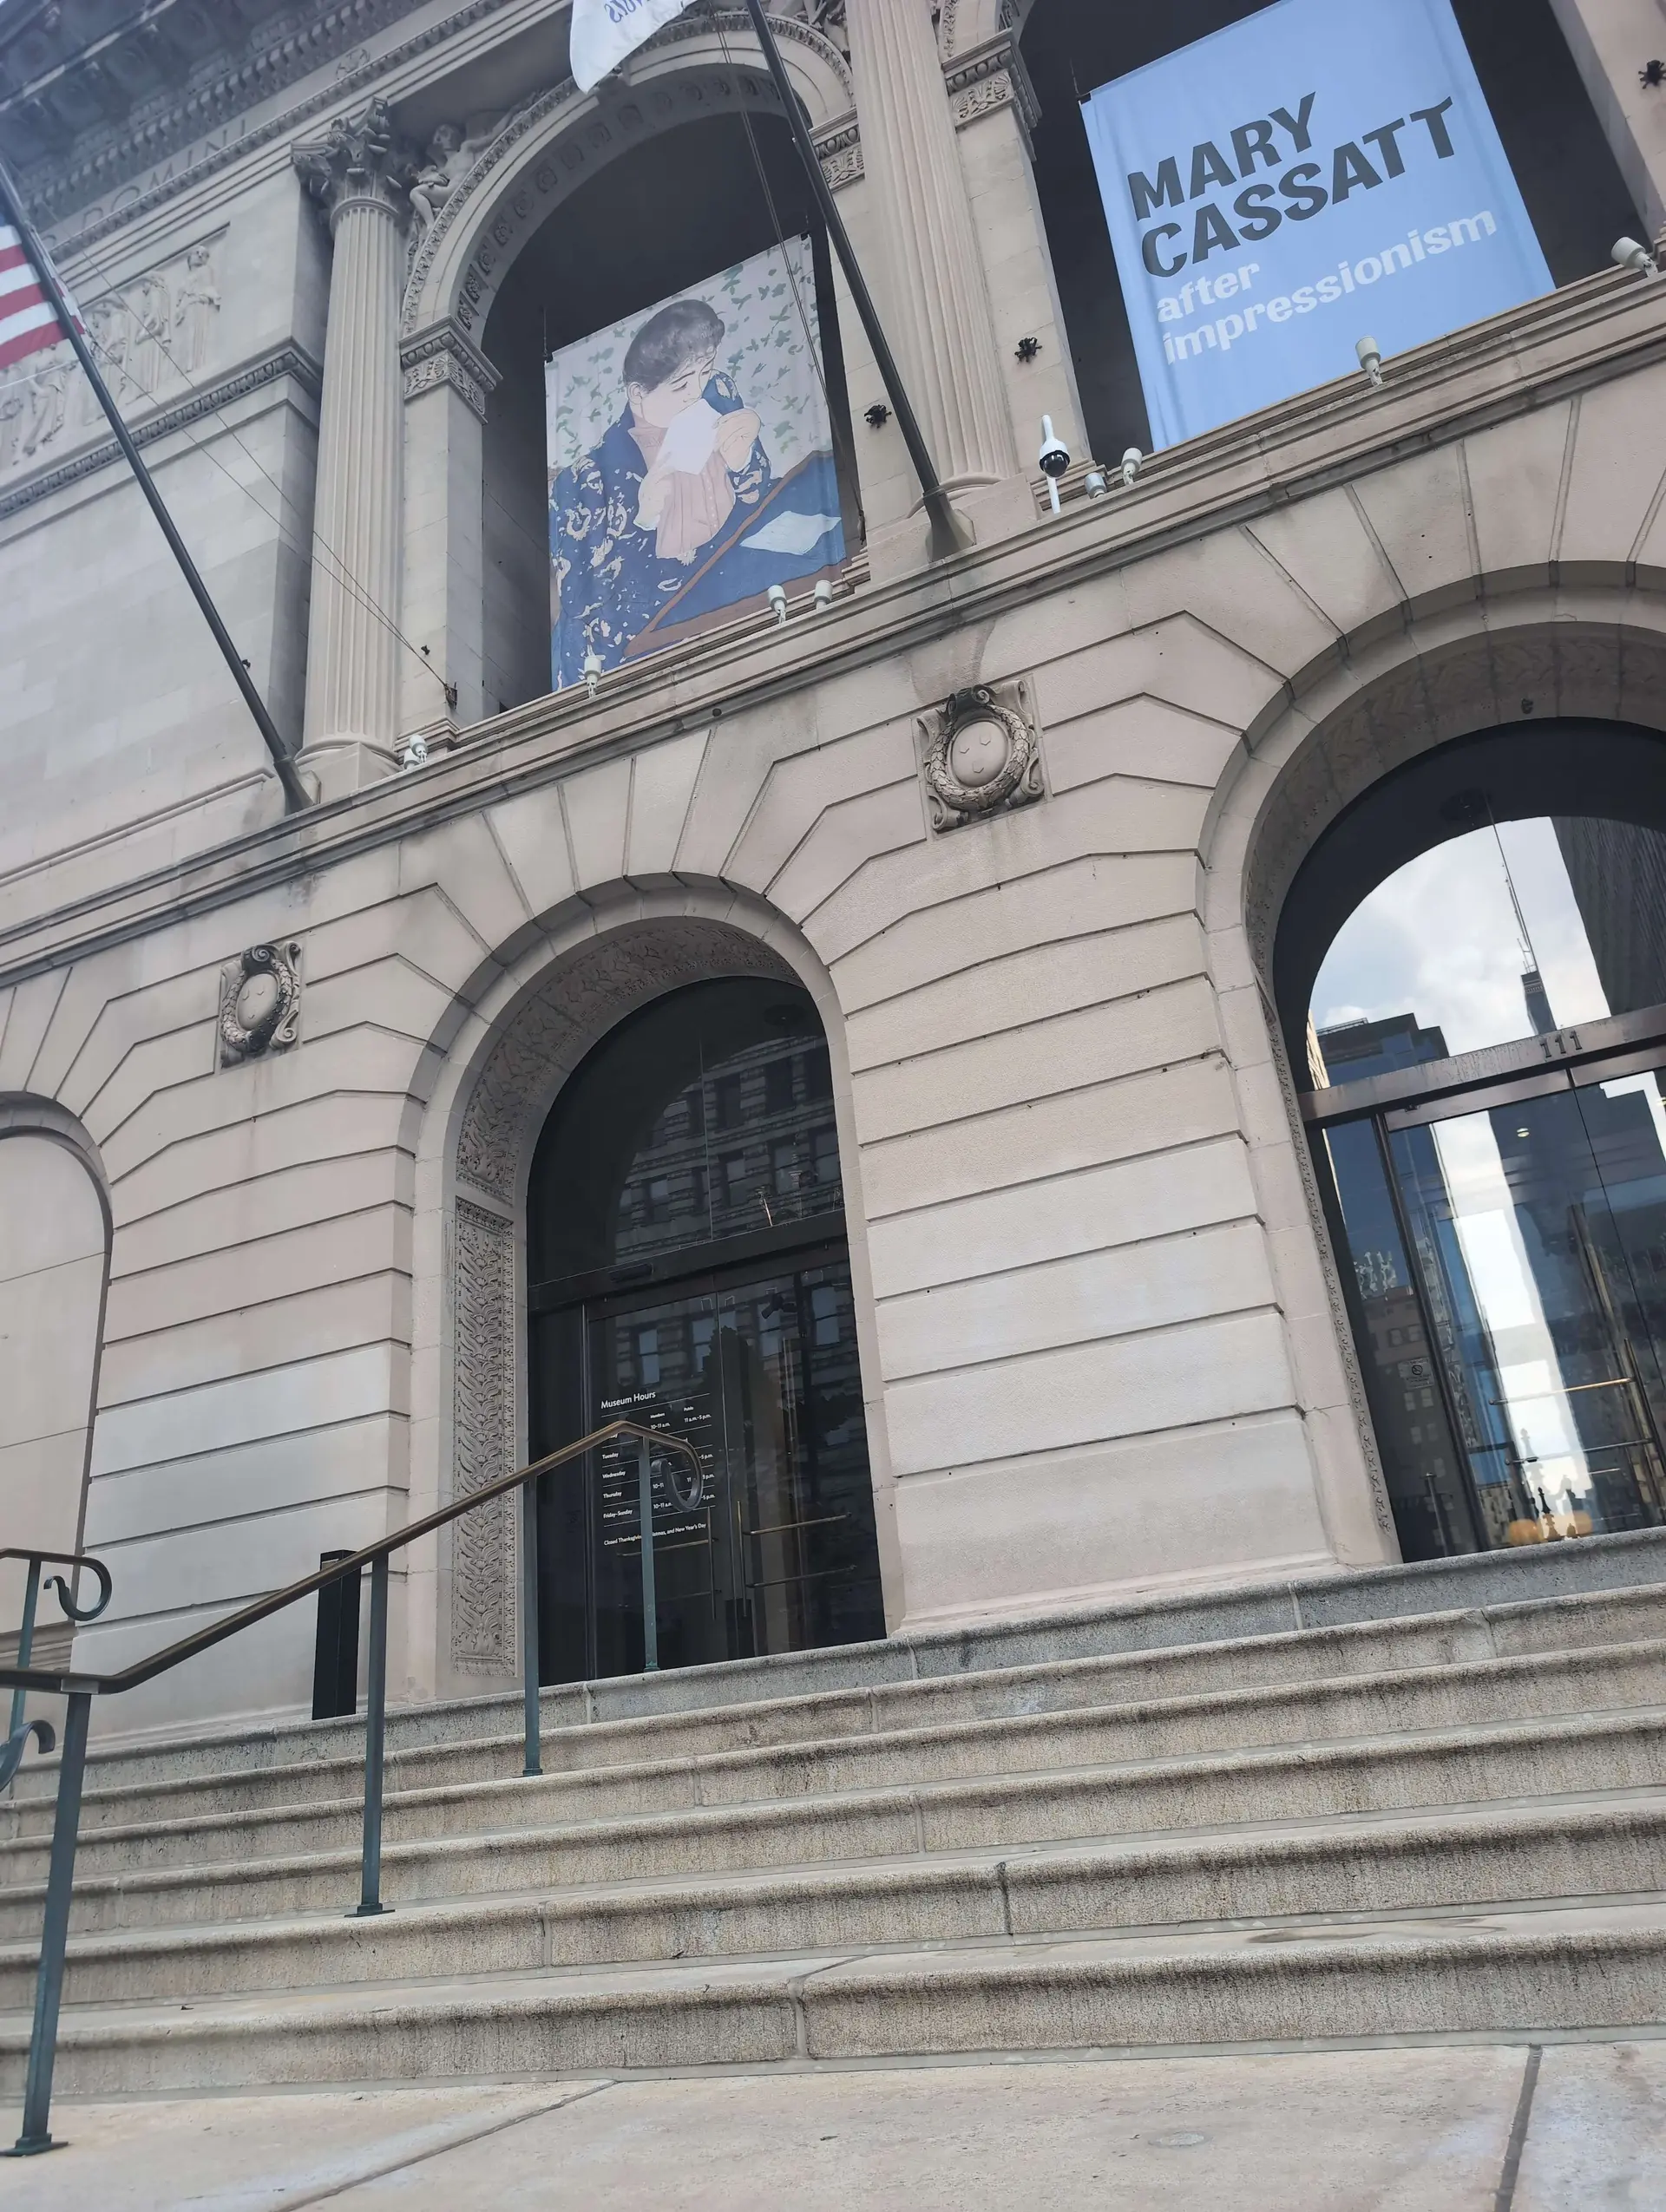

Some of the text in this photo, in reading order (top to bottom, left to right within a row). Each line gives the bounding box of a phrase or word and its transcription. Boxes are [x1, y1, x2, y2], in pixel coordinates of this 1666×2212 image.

[1127, 91, 1316, 221] MARY
[1141, 95, 1453, 278] CASSATT
[1157, 262, 1260, 323] after
[1163, 210, 1498, 365] impressionism
[1539, 1030, 1583, 1058] 111
[600, 1391, 656, 1410] Museum Hours
[618, 1535, 642, 1543] Thanksgivin
